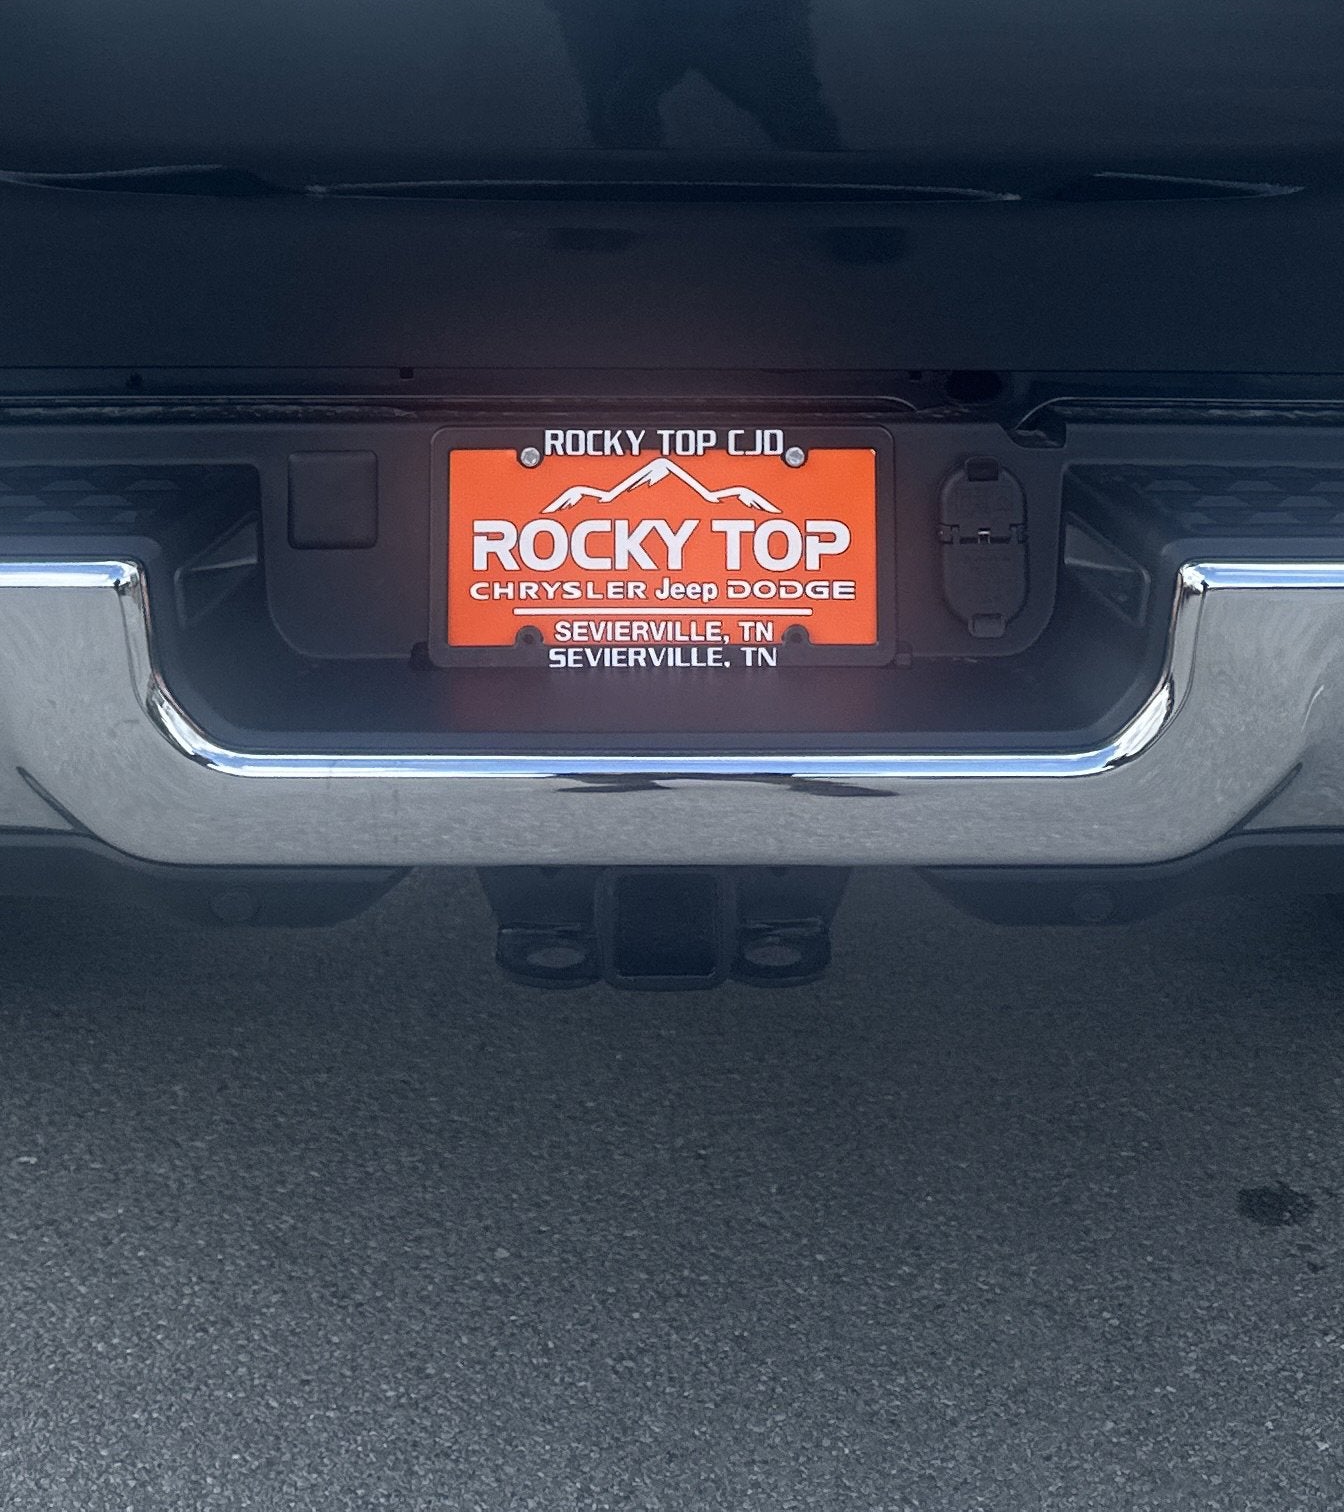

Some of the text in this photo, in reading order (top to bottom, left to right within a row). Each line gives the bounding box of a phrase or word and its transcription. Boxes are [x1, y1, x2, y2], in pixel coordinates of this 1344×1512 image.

[544, 428, 785, 456] ROCKY TOP CJD
[472, 519, 852, 572] ROCKY TOP
[469, 577, 856, 603] CHRYSLER Jeep DODGE
[554, 621, 774, 644] SEVIERVILLE, TN
[741, 647, 777, 667] TN
